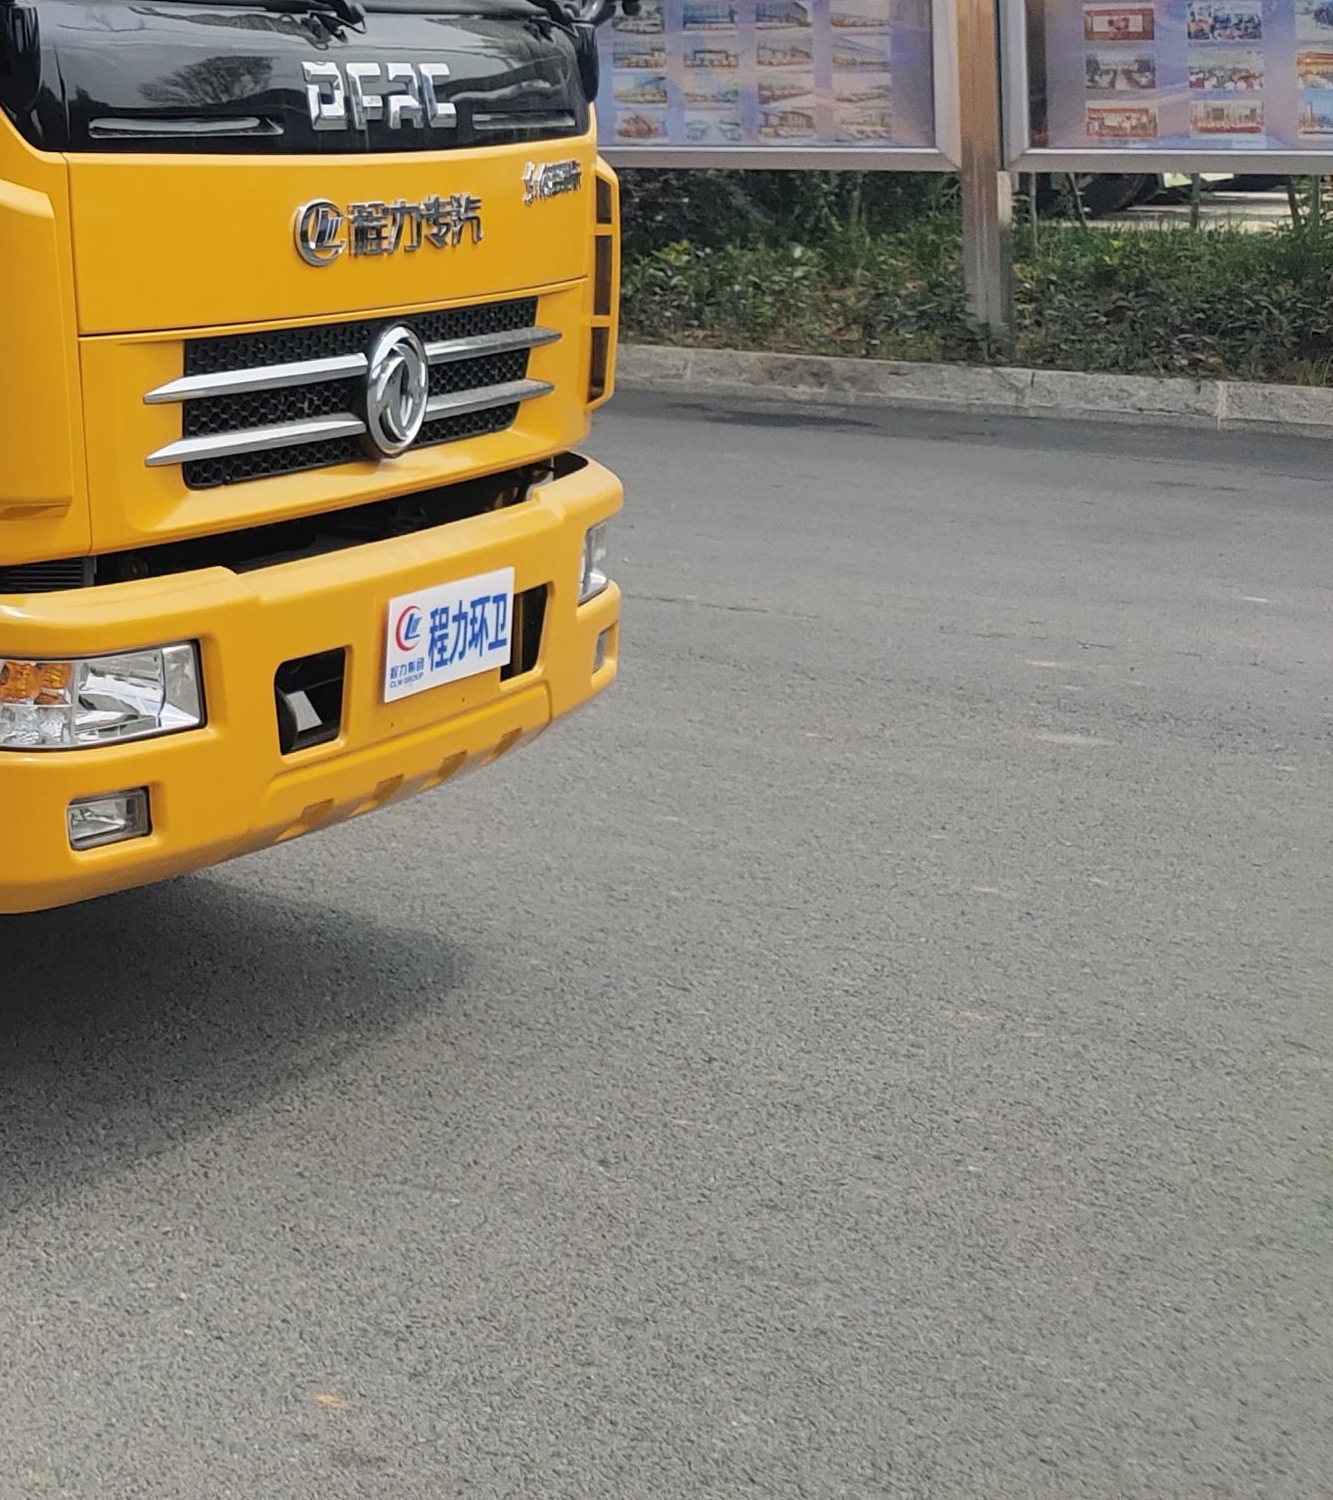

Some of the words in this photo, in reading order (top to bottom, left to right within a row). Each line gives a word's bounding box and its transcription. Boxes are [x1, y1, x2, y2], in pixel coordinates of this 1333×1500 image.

[301, 60, 457, 131] DFAC
[348, 192, 484, 258] 程力专汽
[428, 593, 508, 672] 程力环卫
